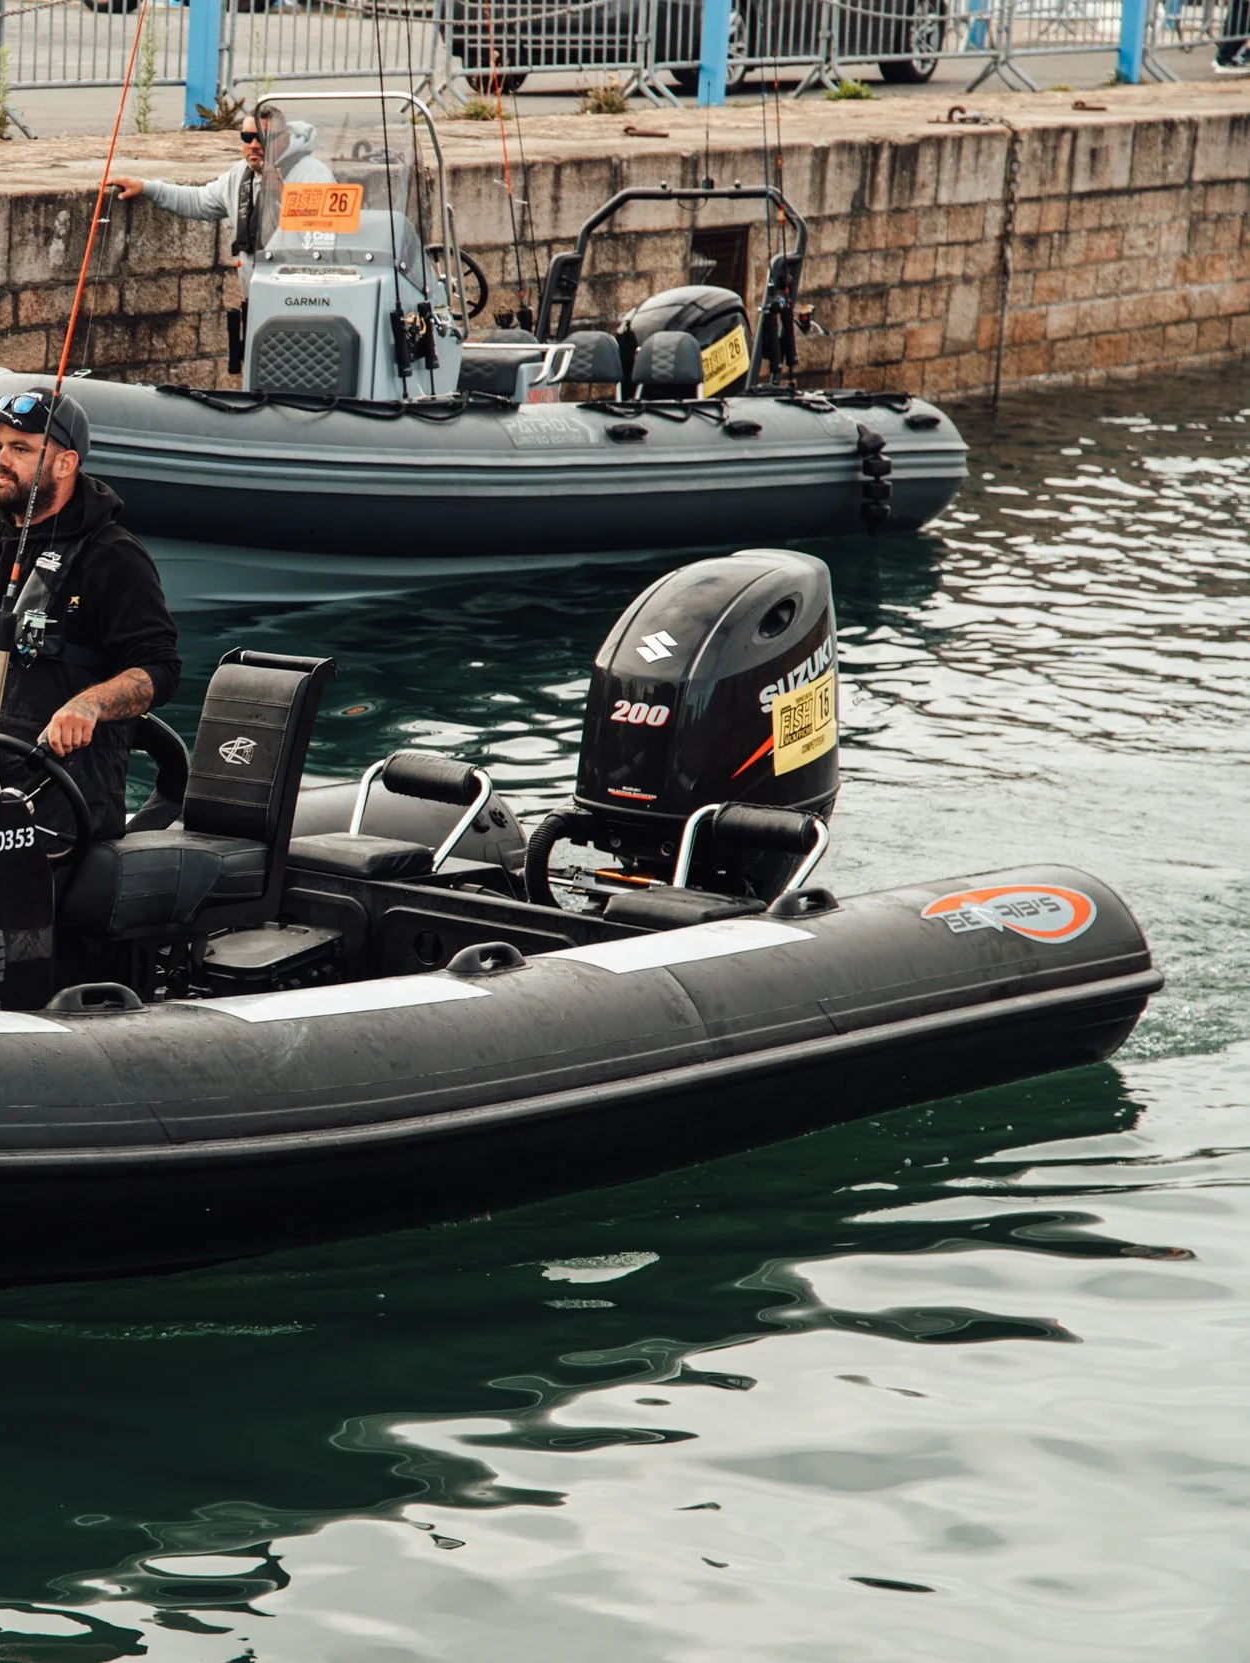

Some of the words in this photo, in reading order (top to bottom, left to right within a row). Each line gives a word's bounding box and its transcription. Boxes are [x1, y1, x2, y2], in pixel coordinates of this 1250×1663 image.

[283, 192, 323, 217] FISH
[328, 192, 348, 213] 26
[284, 296, 330, 307] GARMIN
[729, 338, 741, 359] 26
[501, 417, 579, 433] PATROL
[759, 634, 833, 714] SUZUKI
[610, 699, 671, 727] 200
[819, 686, 830, 720] 15
[779, 698, 813, 748] FISH
